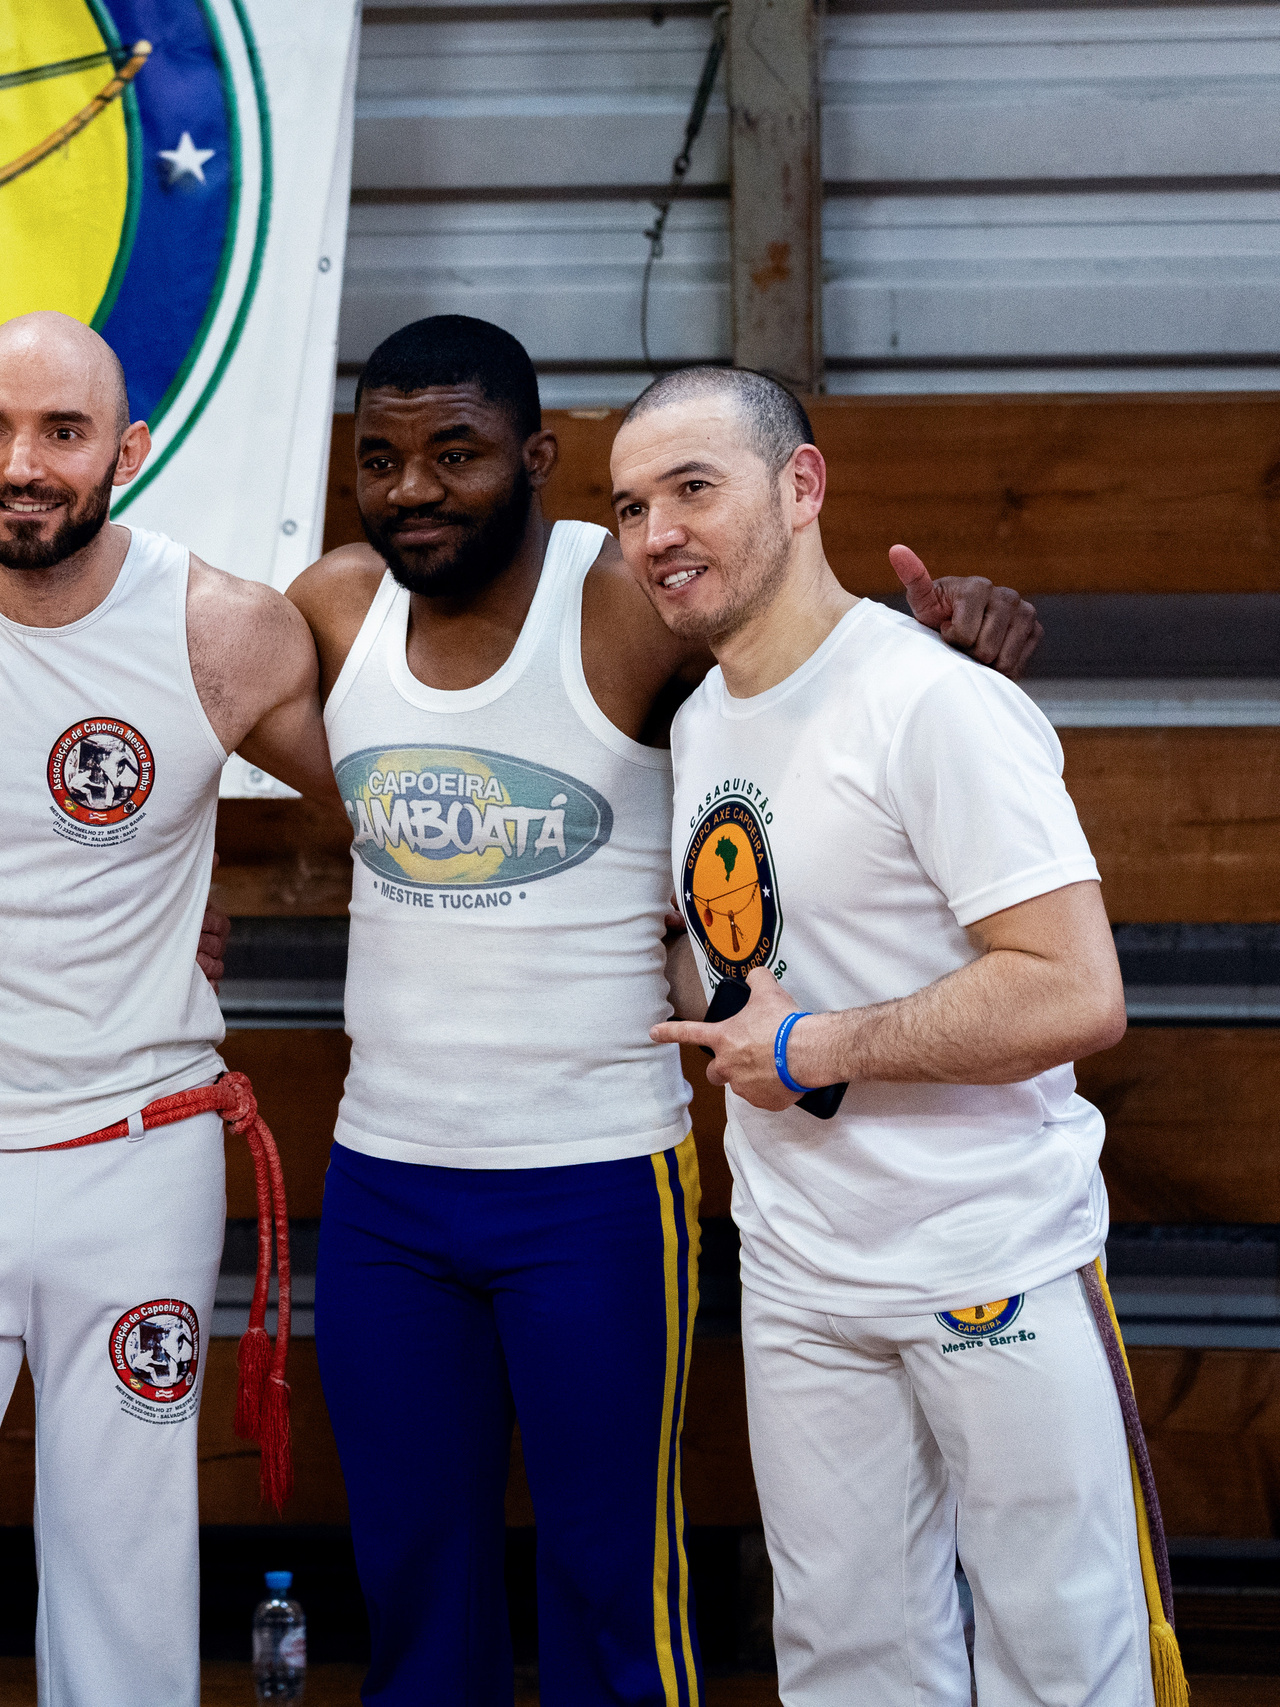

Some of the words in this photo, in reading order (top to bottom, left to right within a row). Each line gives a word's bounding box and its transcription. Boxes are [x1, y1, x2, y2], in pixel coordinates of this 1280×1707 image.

[53, 738, 72, 791] Associação
[71, 728, 83, 740] de
[83, 722, 125, 736] Capoeira
[124, 729, 147, 760] Mestre
[138, 761, 152, 791] Bimba
[369, 771, 503, 800] CAPOEIRA
[690, 778, 773, 828] CASAQUISTÃO
[687, 822, 711, 869] GRUPO
[713, 805, 731, 825] AXÉ
[733, 807, 764, 863] CAPOEIRA
[381, 881, 434, 908] MESTRE
[439, 891, 512, 909] TUCANO
[704, 939, 737, 978] MESTRE
[741, 936, 770, 977] BARRÃO
[113, 1321, 131, 1370] Associação
[129, 1312, 141, 1324] de
[140, 1302, 180, 1316] Capoeira
[941, 1339, 984, 1354] Mestre
[988, 1329, 1036, 1347] Barrão
[957, 1319, 1002, 1333] CAPOEIRA
